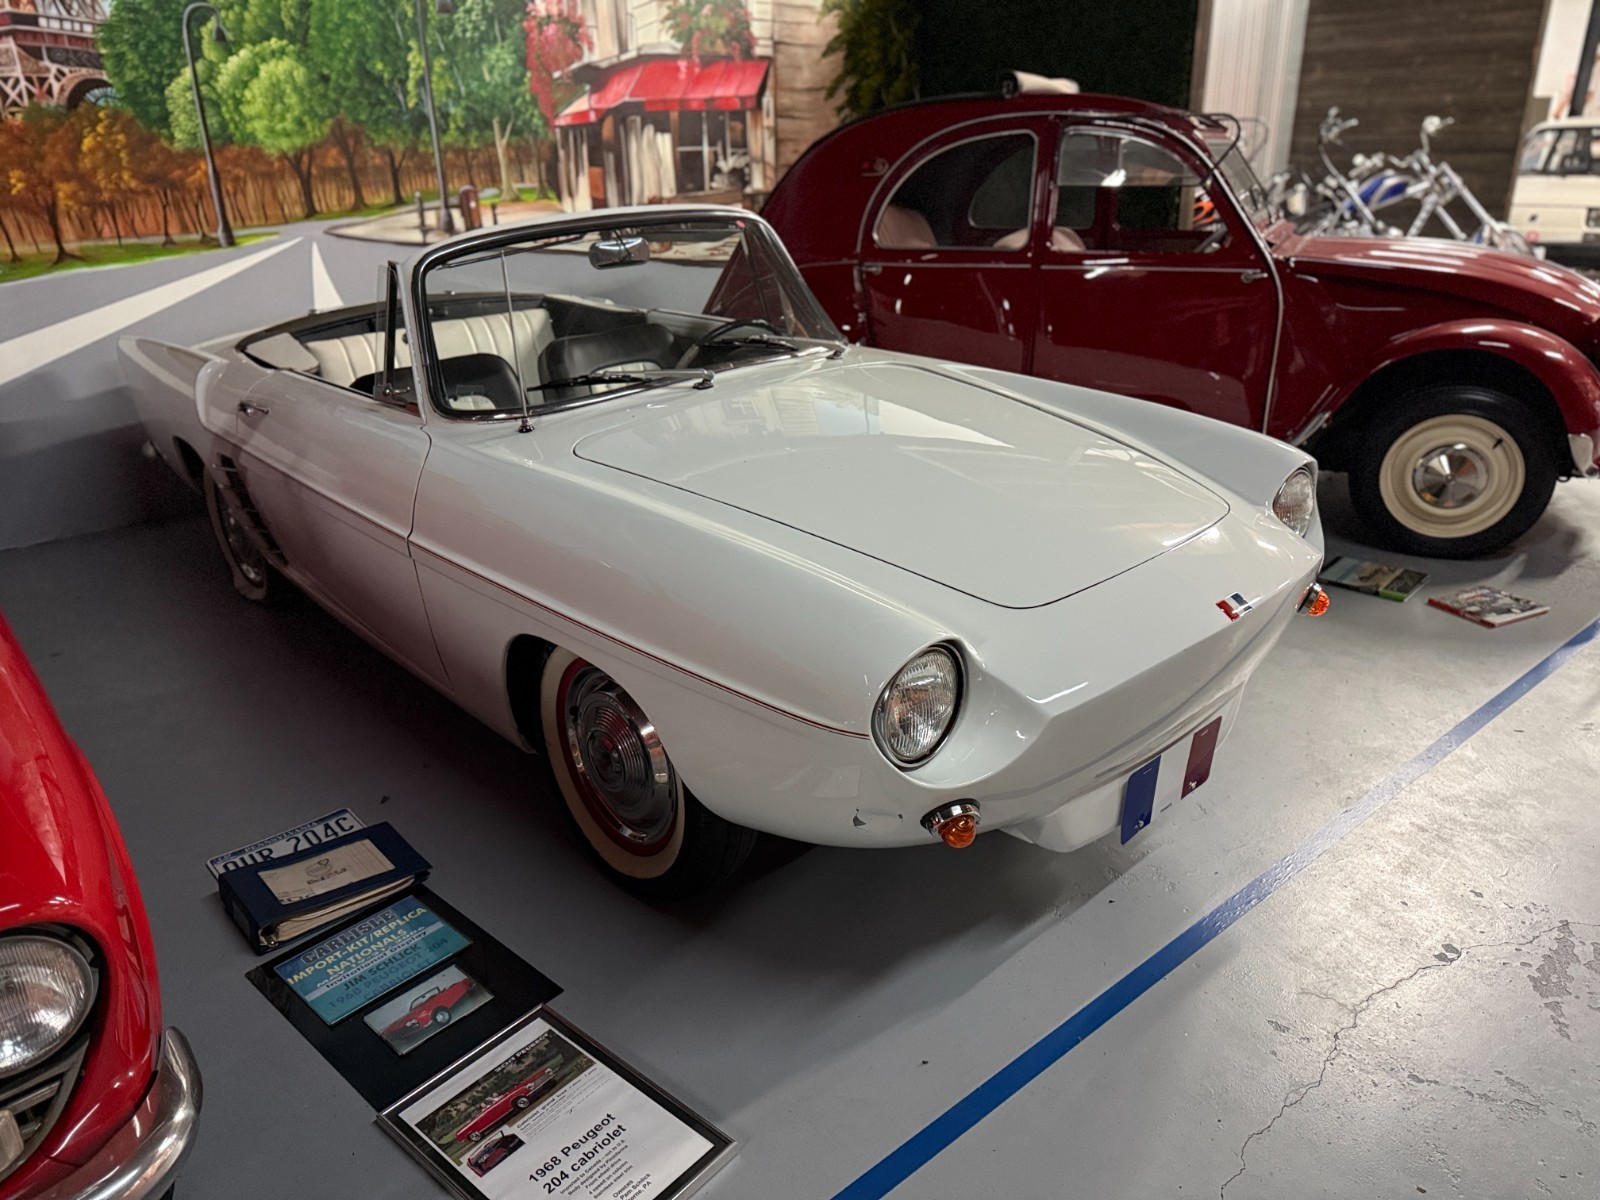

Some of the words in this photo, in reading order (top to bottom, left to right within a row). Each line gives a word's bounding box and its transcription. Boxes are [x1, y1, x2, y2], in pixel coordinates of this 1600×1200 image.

[243, 821, 320, 852] PENNSYLVANIA
[284, 816, 360, 852] 204C
[285, 905, 427, 986] IMPORT-KIT/REPLICA
[298, 908, 397, 965] CARLISLE
[325, 927, 408, 975] NATIONALS
[325, 952, 387, 988] Invitational
[388, 929, 429, 953] Display
[327, 986, 363, 1008] 1968
[362, 951, 424, 989] PEUGEOT
[424, 937, 450, 953] 204
[340, 973, 367, 991] JIM
[366, 942, 421, 976] SCHLICK
[515, 1031, 550, 1057] PEUGEOT
[528, 1156, 562, 1184] 1968
[560, 1113, 616, 1158] Peugeot
[542, 1170, 570, 1194] 204
[570, 1124, 627, 1172] cabriolet
[558, 1176, 581, 1195] Imported
[583, 1158, 602, 1173] Canada
[567, 1184, 581, 1196] Body
[578, 1167, 601, 1186] designed
[584, 1177, 598, 1189] Front
[596, 1166, 611, 1178] wheel
[608, 1157, 622, 1168] drive
[591, 1178, 607, 1192] speed
[610, 1160, 629, 1175] column
[592, 1181, 614, 1199] Stainless
[612, 1171, 625, 1182] steel
[622, 1164, 634, 1173] trim
[611, 1179, 634, 1198] OWNERS
[619, 1188, 633, 1200] Pam
[630, 1172, 651, 1190] Schlick
[641, 1180, 652, 1189] PA
